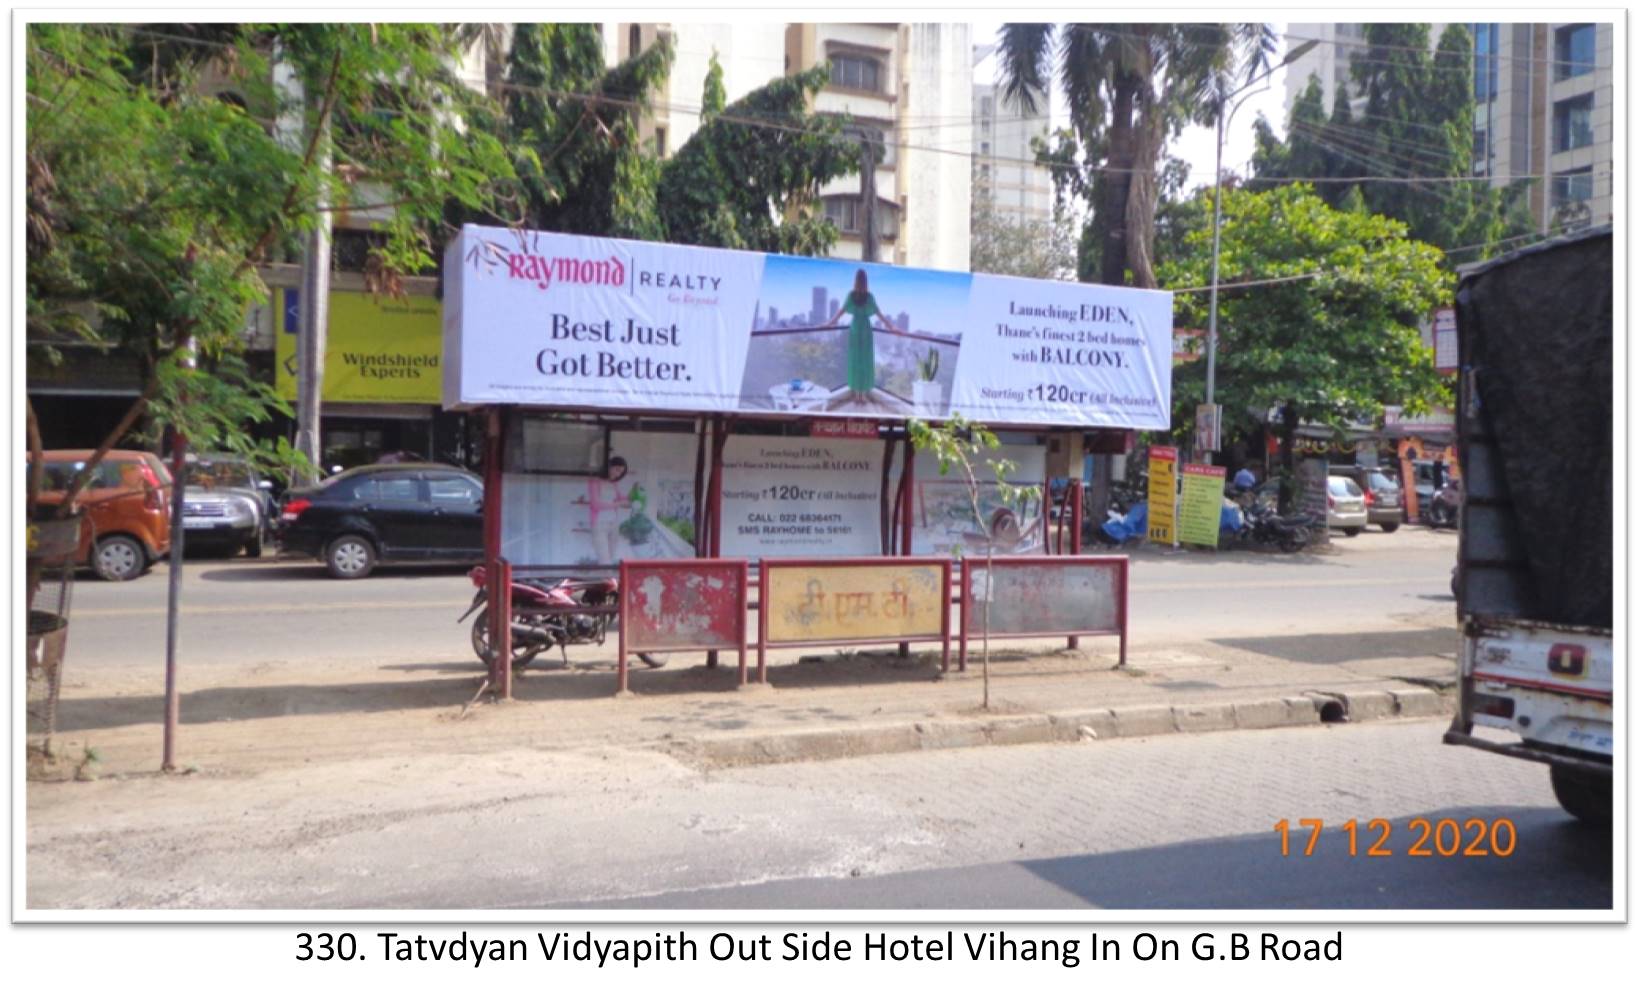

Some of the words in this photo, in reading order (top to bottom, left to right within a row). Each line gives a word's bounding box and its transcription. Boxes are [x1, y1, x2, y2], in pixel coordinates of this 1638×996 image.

[508, 253, 625, 290] Raymond
[640, 271, 722, 291] REALTY
[1009, 301, 1078, 323] Launching
[1079, 304, 1134, 327] EDEN,
[551, 313, 616, 343] Best
[620, 318, 682, 347] Just
[996, 323, 1041, 338] Thane's
[1042, 327, 1075, 342] finest
[1077, 330, 1086, 342] 2
[1087, 331, 1109, 345] bed
[343, 353, 439, 367] Windshield
[536, 348, 592, 377] Got
[597, 351, 693, 382] Better.
[1012, 350, 1037, 363] with
[1041, 346, 1129, 369] BALCONY.
[360, 365, 421, 380] Experts
[981, 387, 1024, 403] Starting
[779, 513, 797, 523] 022
[737, 525, 760, 535] SMS
[762, 525, 812, 536] RAYHOME
